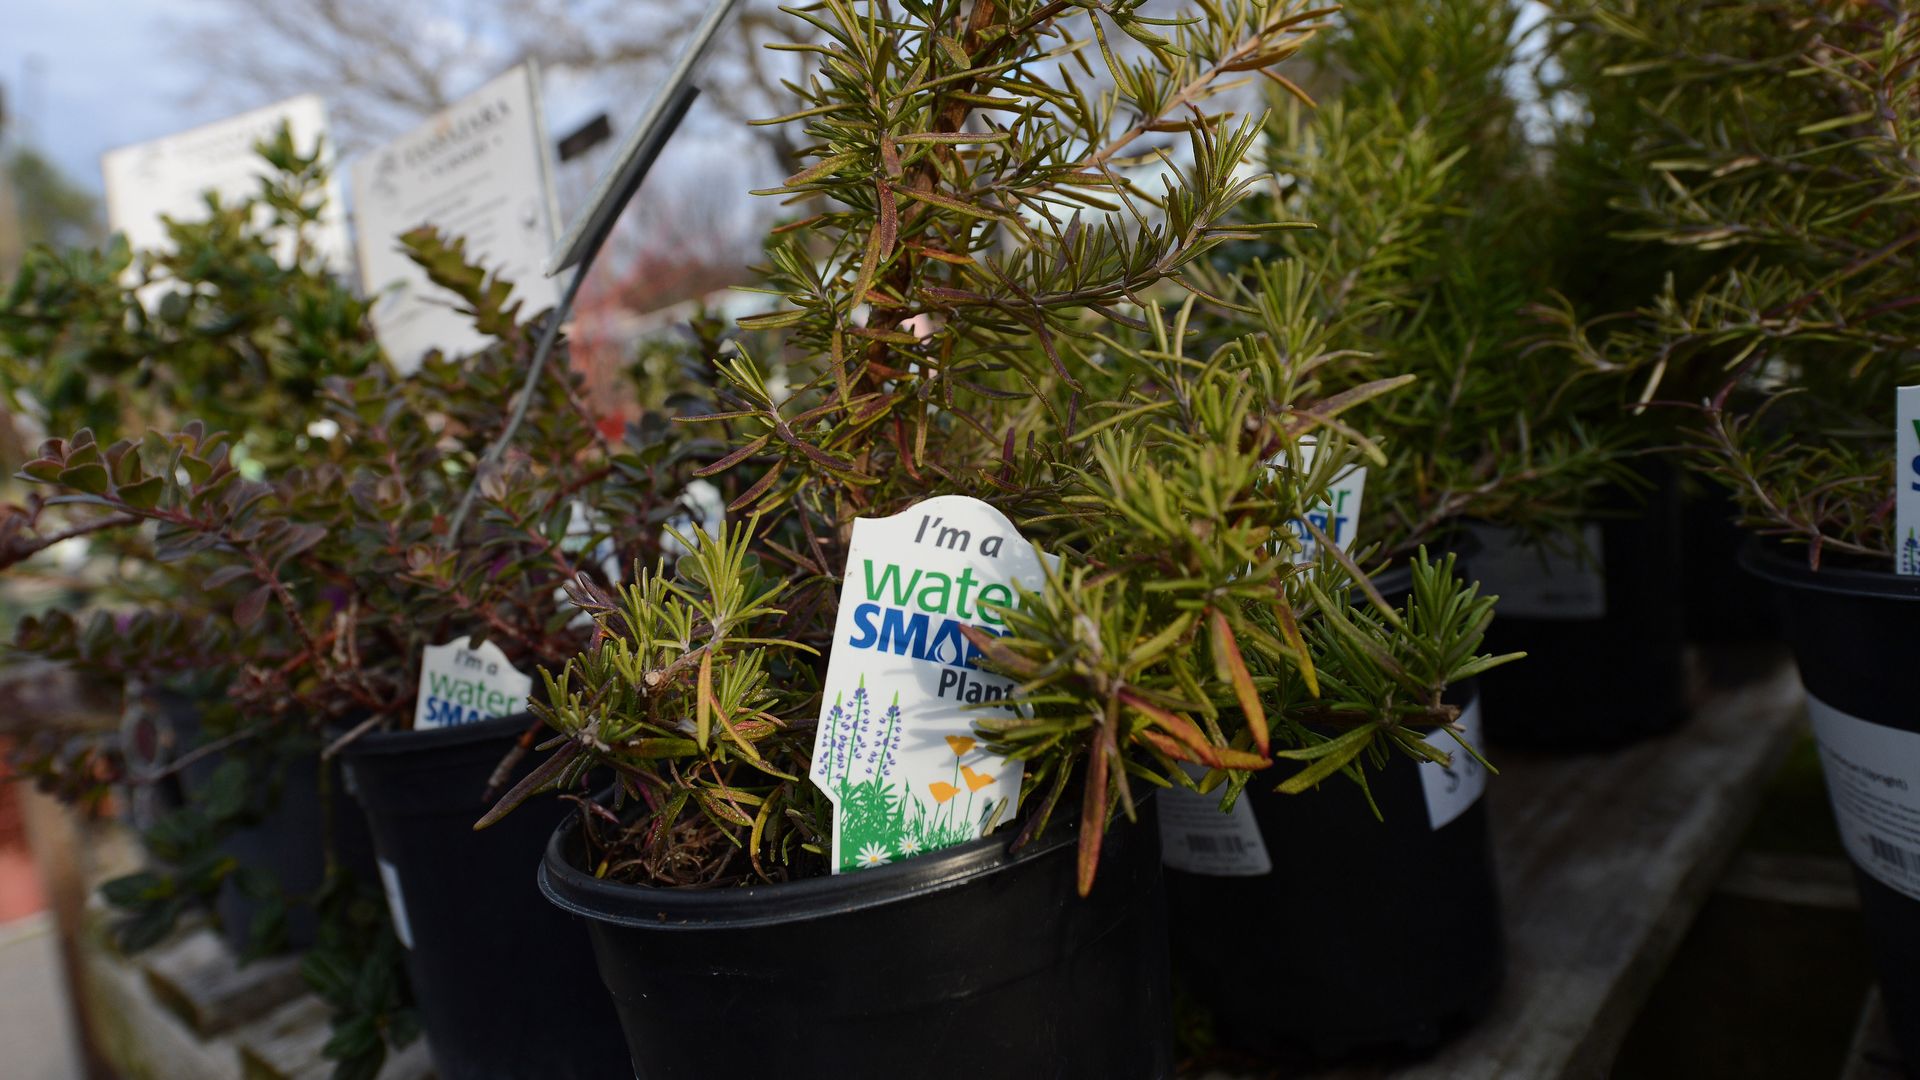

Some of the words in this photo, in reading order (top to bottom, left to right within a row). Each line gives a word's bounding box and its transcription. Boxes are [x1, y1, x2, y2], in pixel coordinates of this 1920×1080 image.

[914, 514, 970, 552] I'm
[979, 535, 1004, 558] a
[863, 559, 1041, 625] wate
[849, 603, 1015, 675] SMAR
[454, 650, 482, 671] I'm
[486, 663, 498, 676] a
[424, 696, 499, 727] SMA
[429, 670, 517, 717] water
